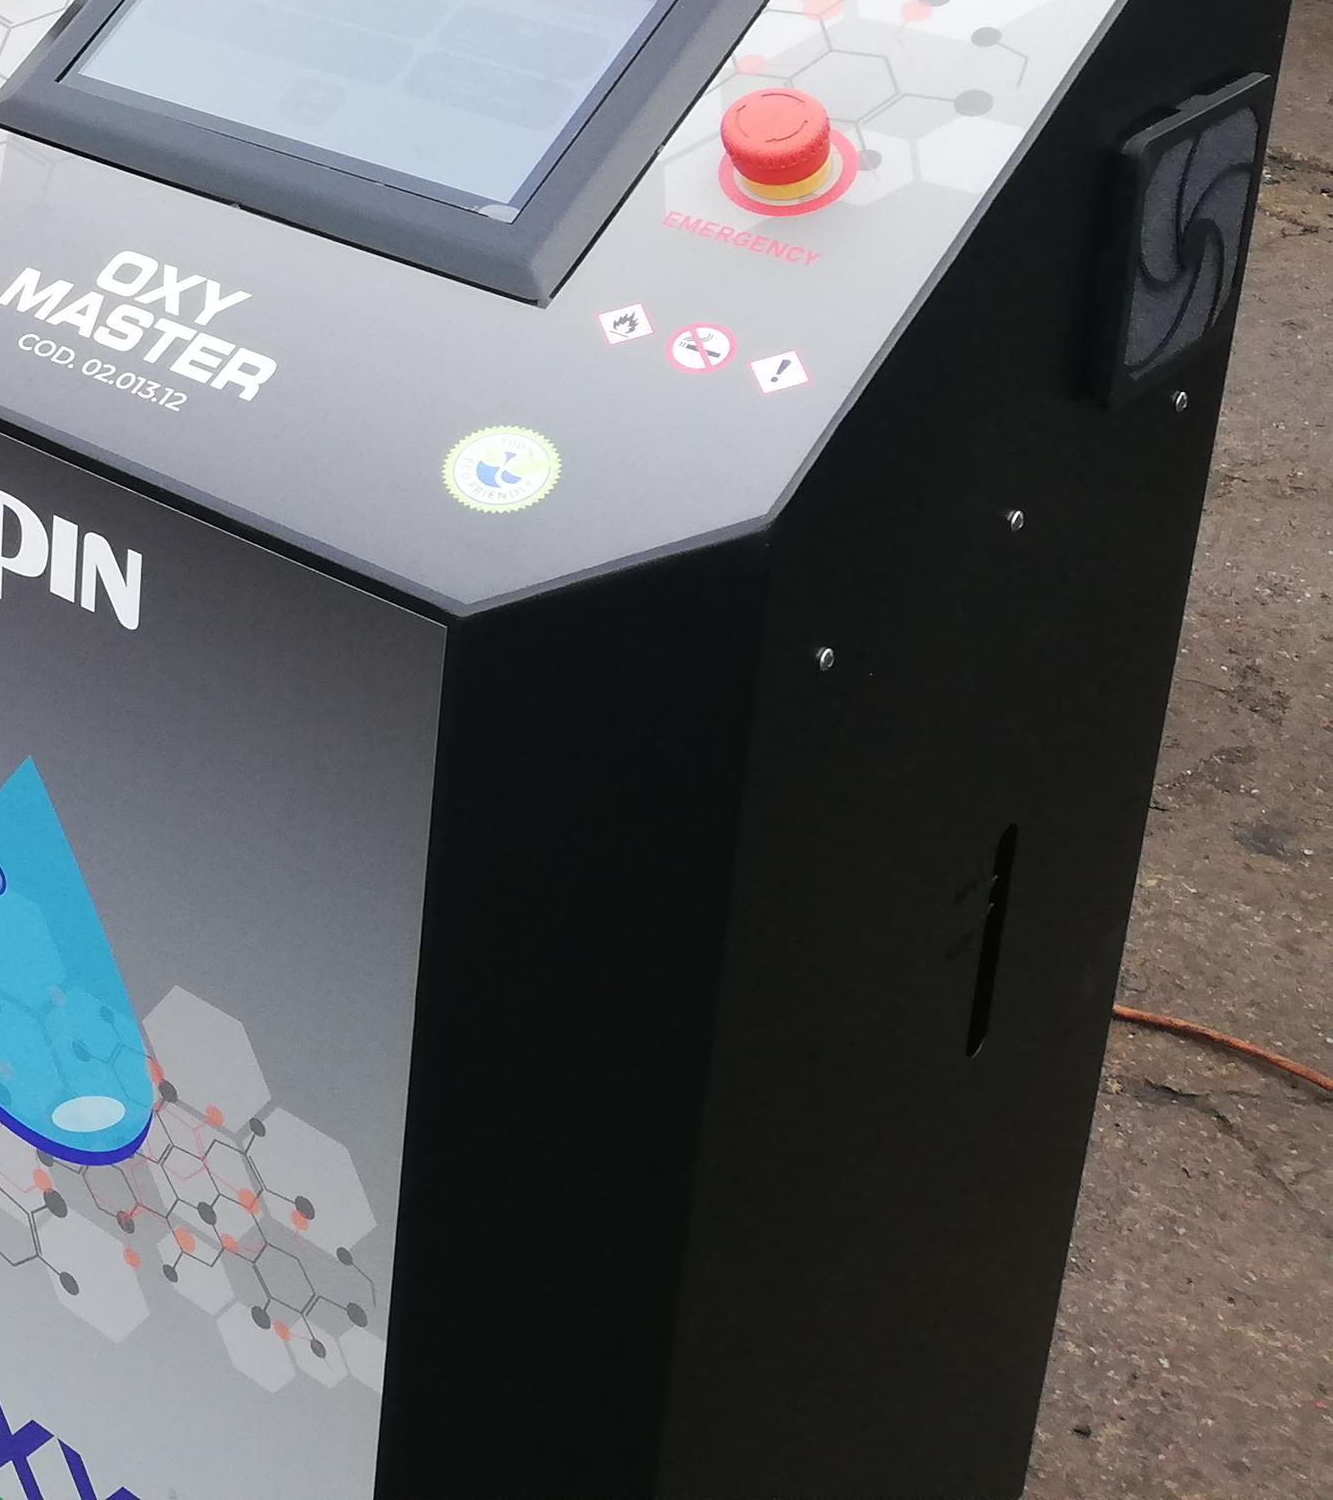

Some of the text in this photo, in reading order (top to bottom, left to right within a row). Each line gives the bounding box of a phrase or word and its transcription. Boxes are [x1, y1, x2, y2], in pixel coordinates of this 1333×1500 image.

[662, 210, 821, 267] EMERGENCY
[96, 250, 252, 327] OXY
[17, 333, 188, 412] COD. 02.013.12
